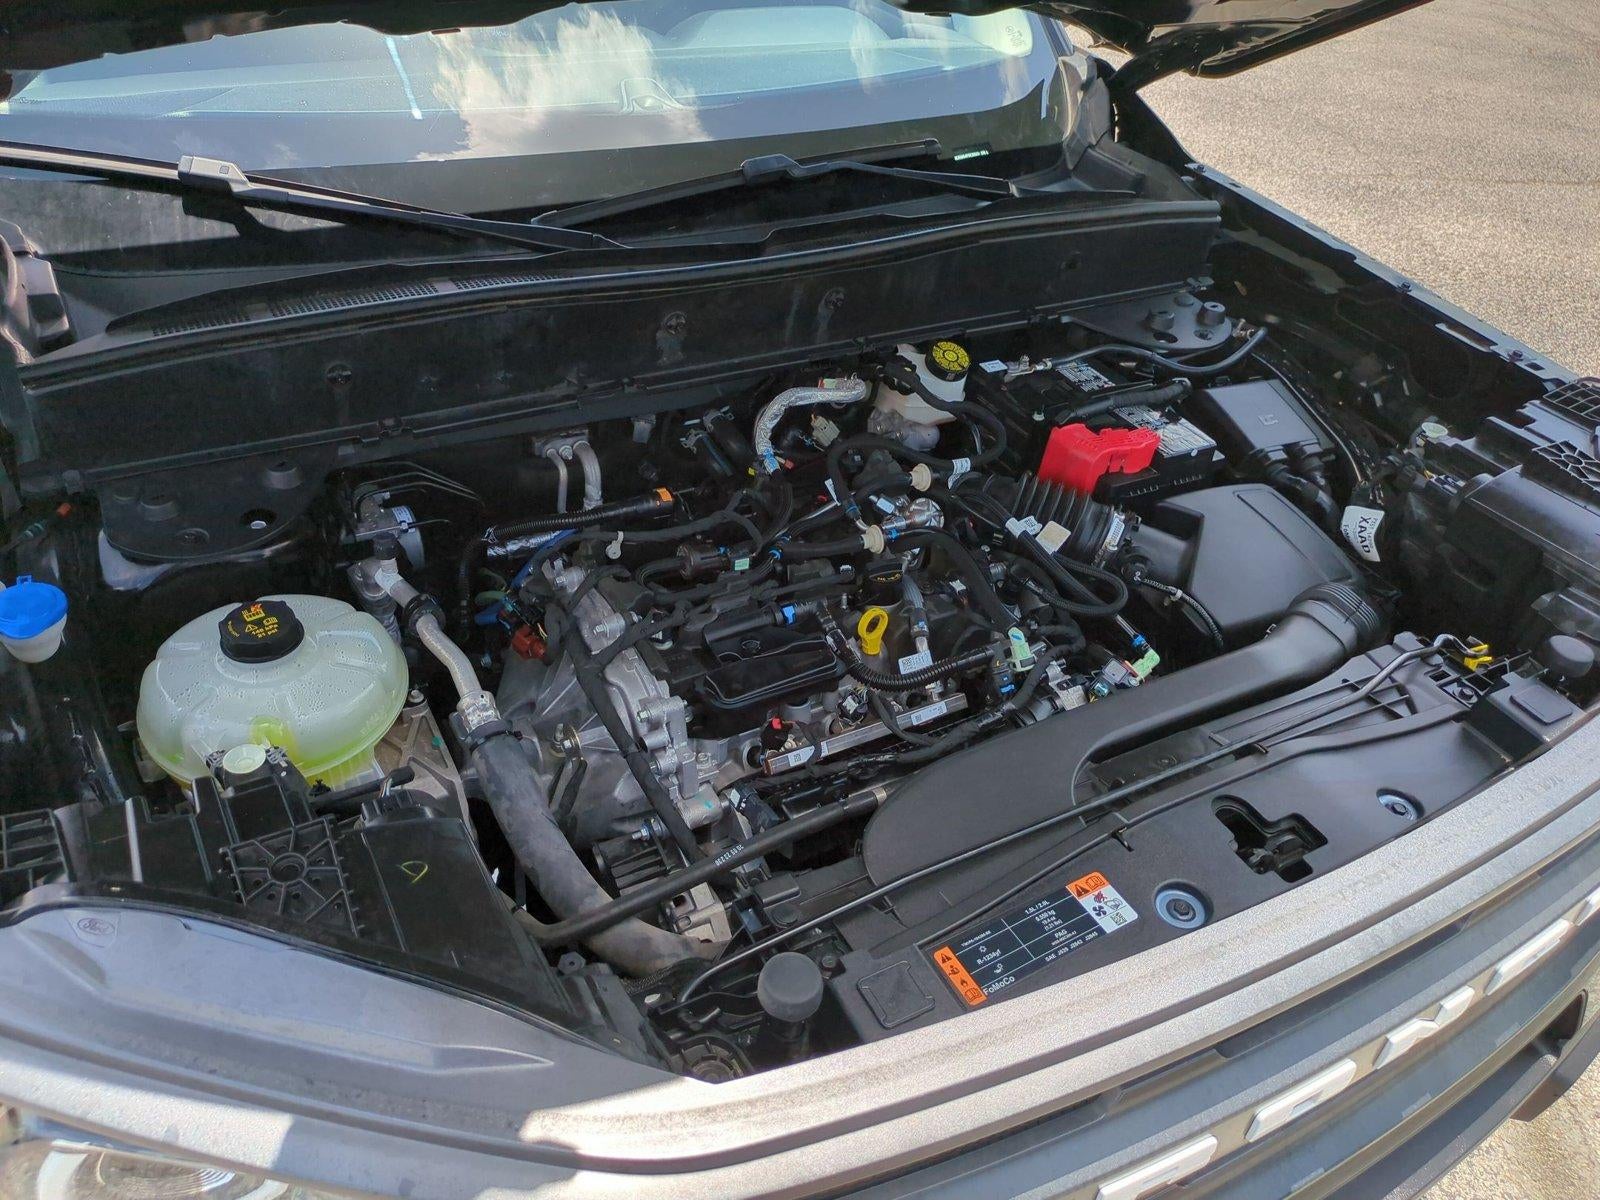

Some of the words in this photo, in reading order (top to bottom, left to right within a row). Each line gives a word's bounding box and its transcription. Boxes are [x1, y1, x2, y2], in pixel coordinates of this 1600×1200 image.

[1358, 516, 1371, 553] XAAD
[1054, 929, 1067, 939] PAG
[976, 949, 1002, 965] R-1234yf
[1045, 953, 1057, 962] SAE
[982, 976, 1016, 996] FoMoCo
